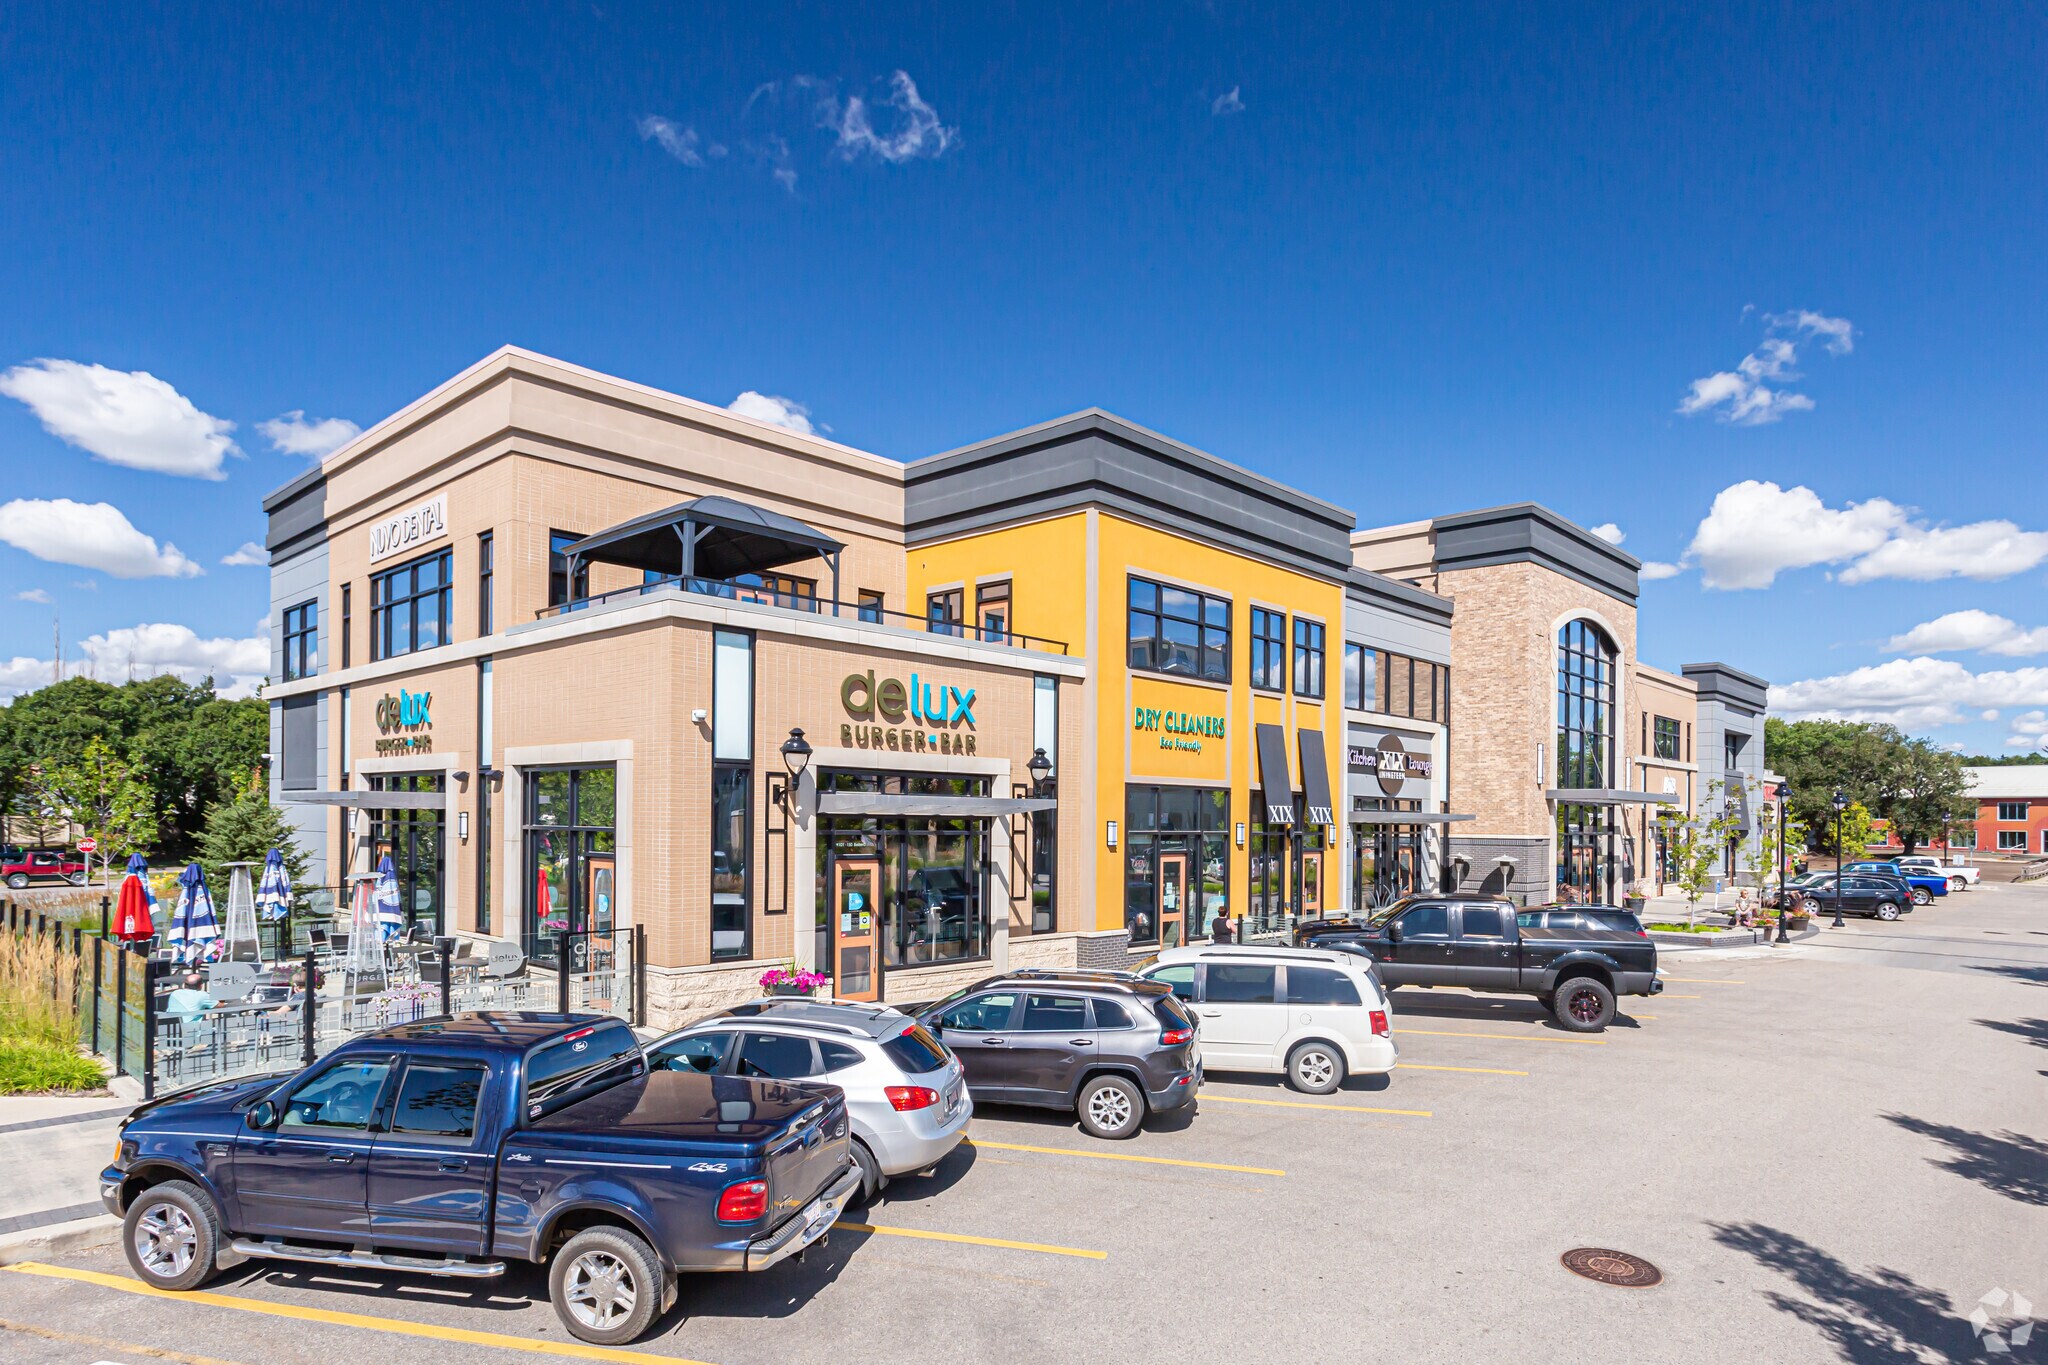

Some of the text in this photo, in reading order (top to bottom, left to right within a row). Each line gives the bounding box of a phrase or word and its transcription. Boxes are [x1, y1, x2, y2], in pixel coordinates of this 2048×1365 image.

[371, 502, 443, 556] NUVO DENTAL
[376, 688, 432, 728] delux
[841, 669, 976, 723] delux
[1135, 707, 1225, 737] DRY CLEANERS
[841, 724, 976, 751] BURGER BAR
[1160, 736, 1201, 754] Eco Friendly
[1347, 748, 1377, 766] Kitchen
[1269, 805, 1333, 824] XIX XIX
[78, 841, 97, 849] STOP
